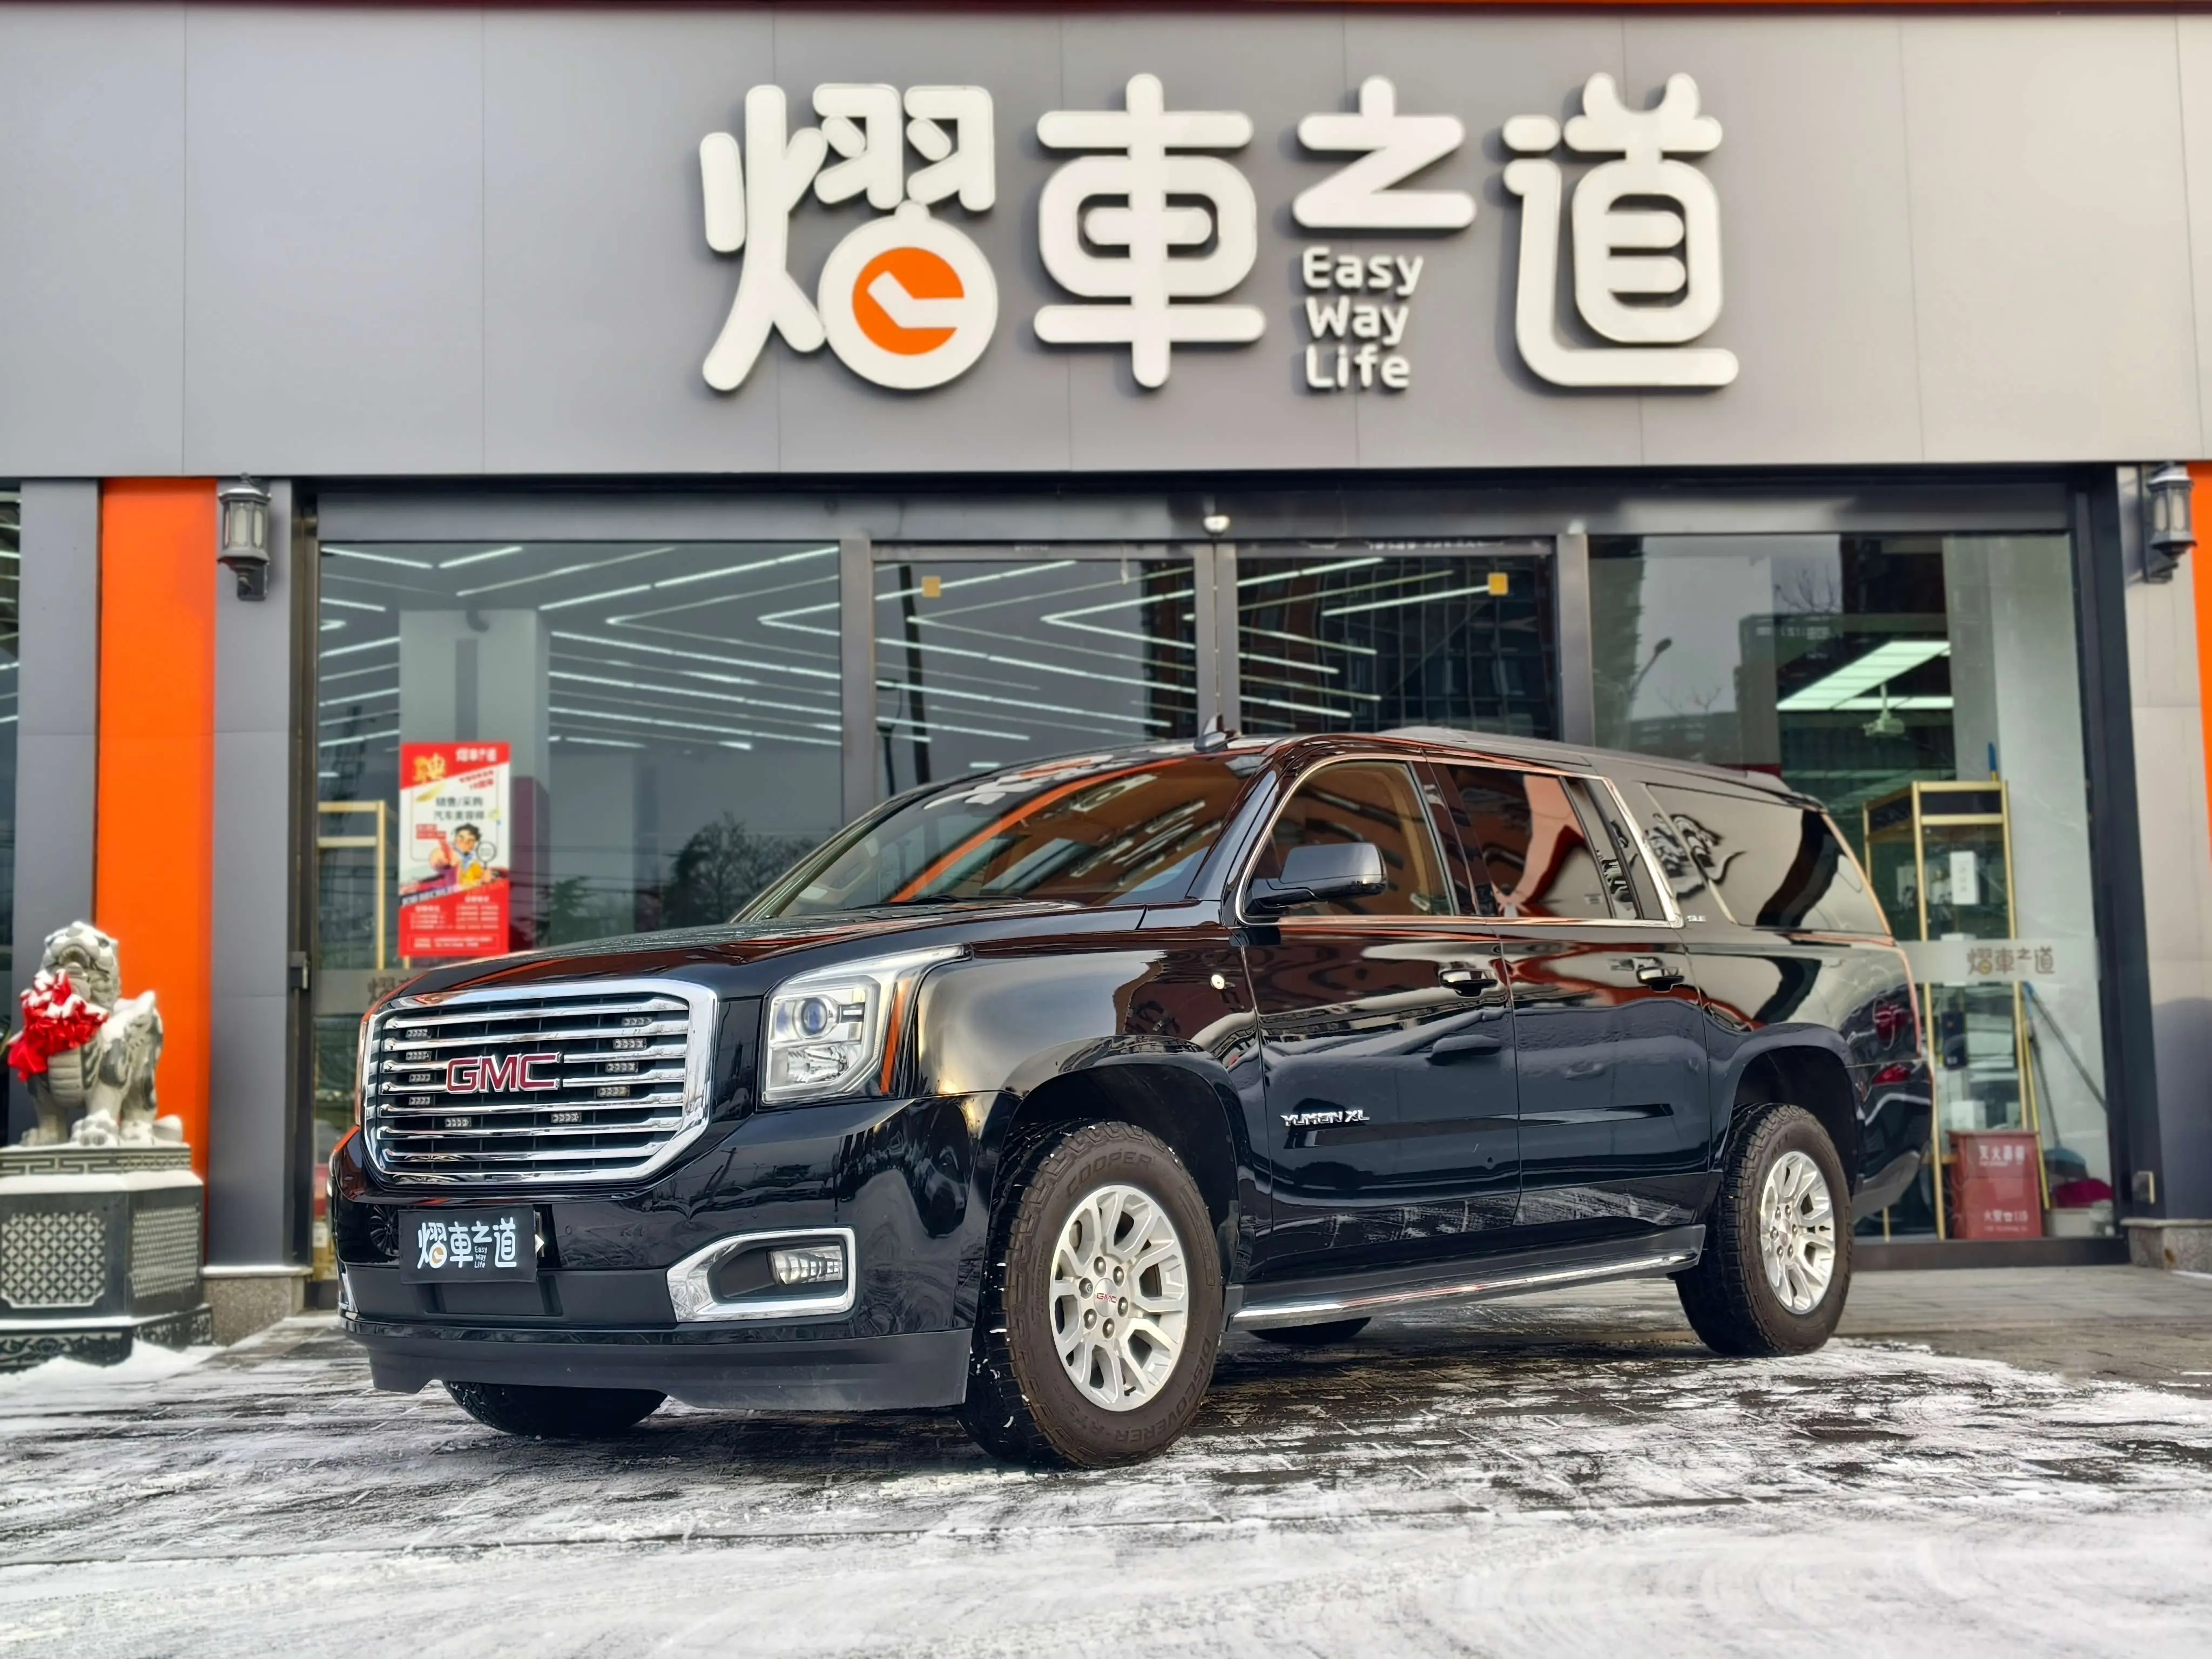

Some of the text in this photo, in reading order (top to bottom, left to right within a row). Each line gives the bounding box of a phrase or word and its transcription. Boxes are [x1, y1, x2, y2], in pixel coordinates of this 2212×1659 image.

[1303, 246, 1424, 295] Easy
[1306, 296, 1409, 346] Way
[1306, 344, 1411, 389] Life
[446, 1052, 561, 1094] GMC
[1280, 1109, 1370, 1127] YUKON XL
[1067, 1151, 1152, 1197] COOPER
[475, 1253, 486, 1262] Way
[1097, 1292, 1117, 1303] GMC
